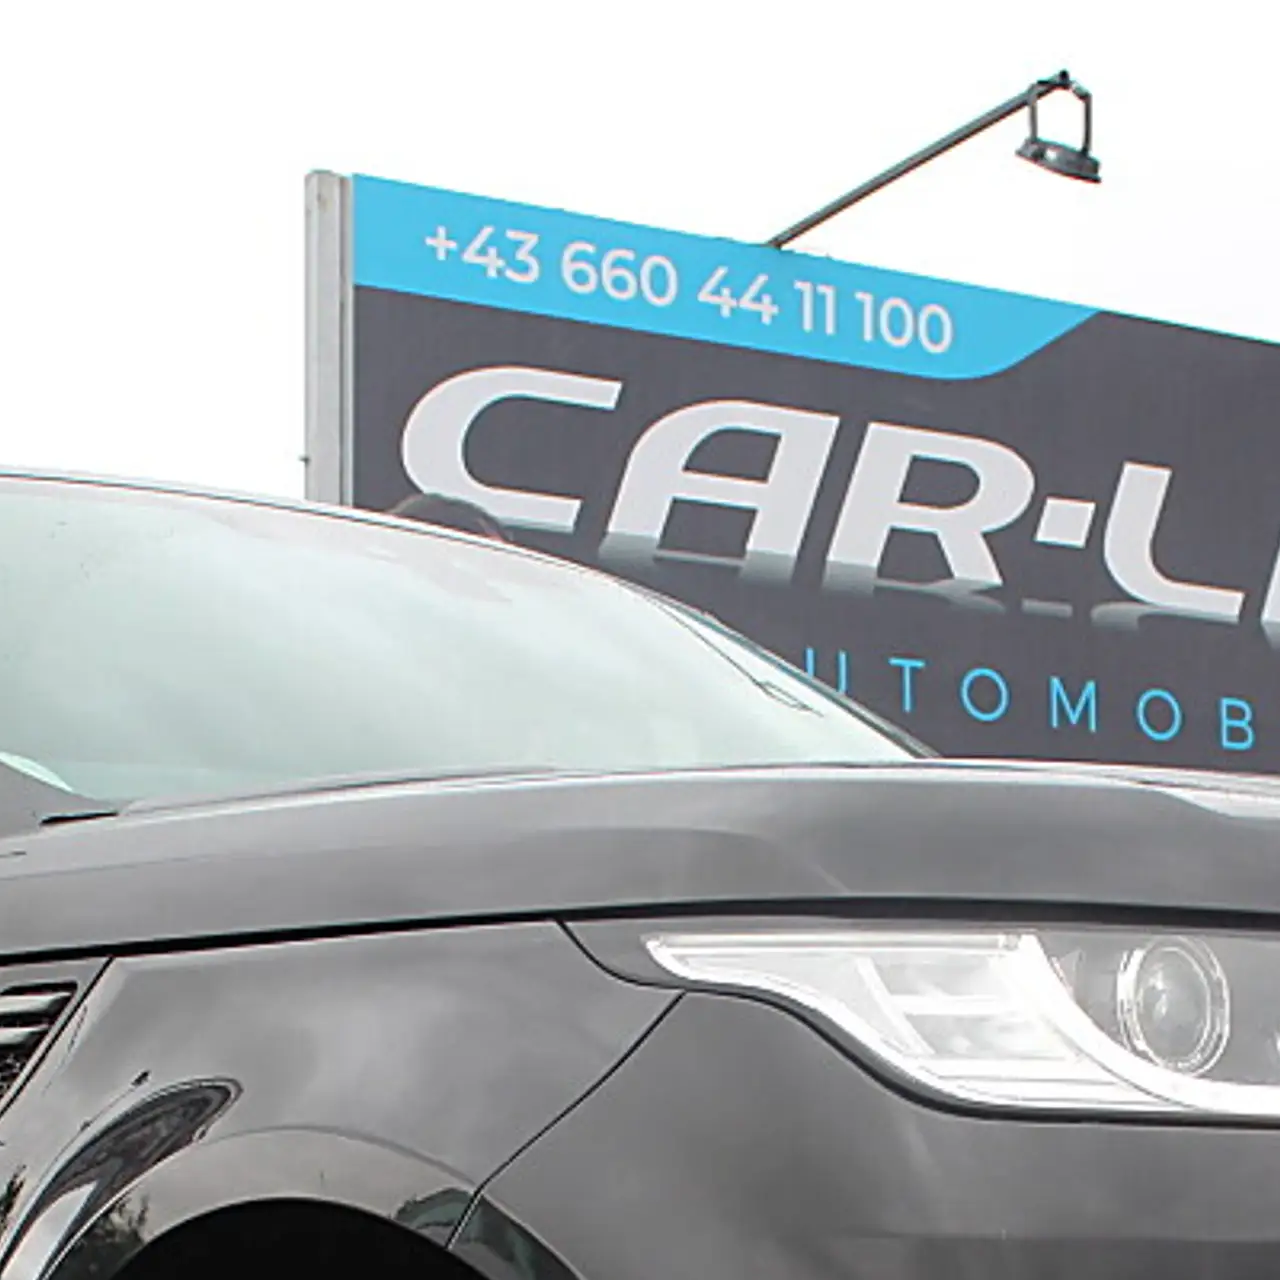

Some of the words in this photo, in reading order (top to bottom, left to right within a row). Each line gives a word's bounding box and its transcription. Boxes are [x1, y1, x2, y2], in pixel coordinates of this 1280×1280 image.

[425, 225, 540, 283] +43
[561, 240, 679, 307] 660
[697, 266, 779, 326] 44
[793, 279, 836, 335] 11
[854, 291, 953, 355] 100
